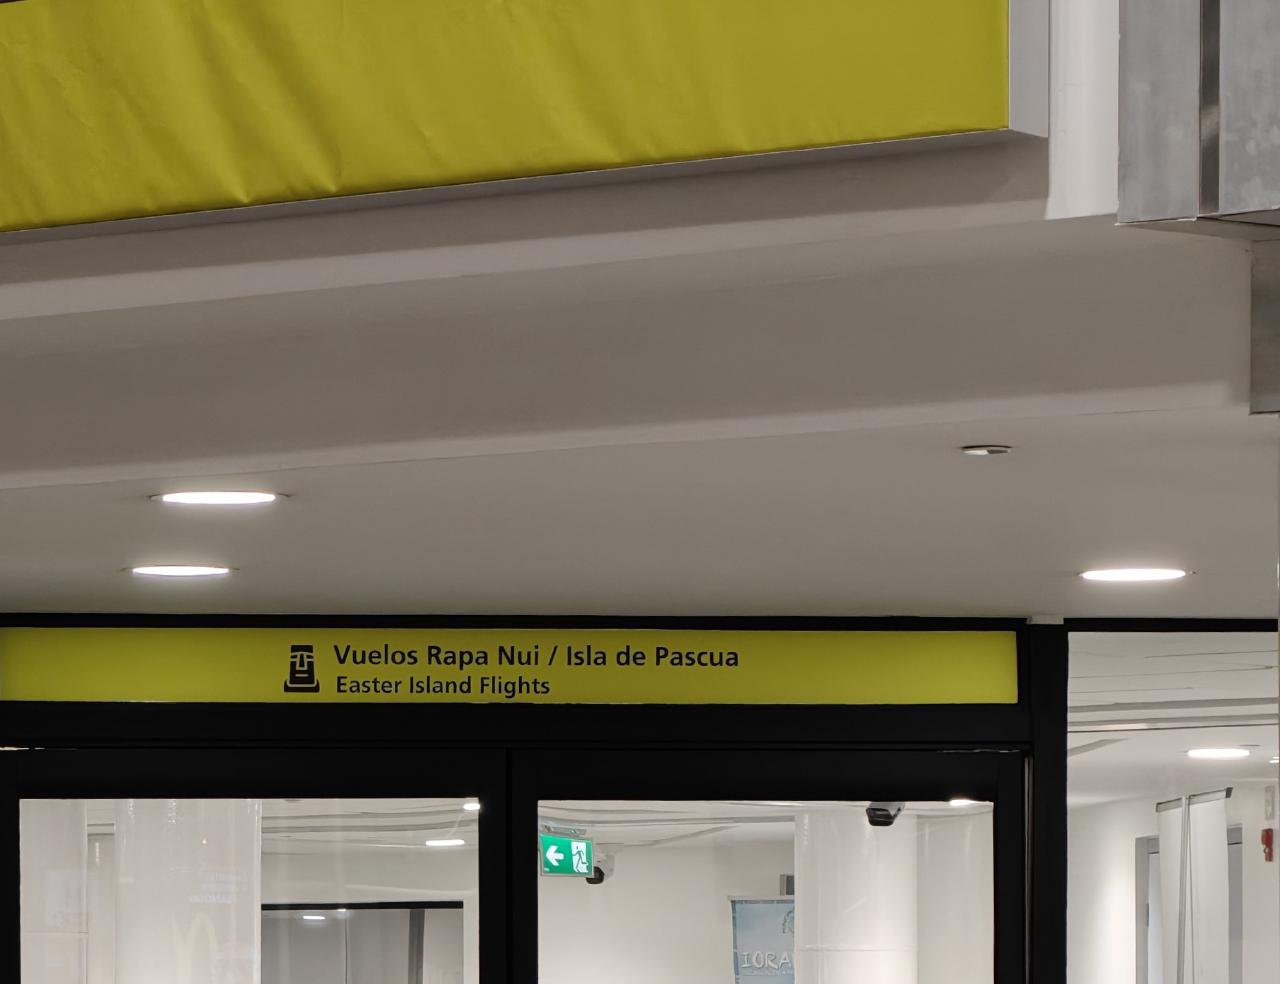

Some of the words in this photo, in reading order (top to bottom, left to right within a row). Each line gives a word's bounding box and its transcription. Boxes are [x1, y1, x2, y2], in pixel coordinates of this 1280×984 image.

[333, 643, 418, 666] Vuelos
[427, 645, 489, 671] Rapa
[498, 644, 539, 666] Nui
[547, 645, 558, 666] /
[567, 644, 607, 666] Isla
[616, 644, 646, 666] de
[655, 646, 739, 667] Pascua
[336, 675, 403, 694] Easter
[409, 675, 472, 694] Island
[480, 675, 550, 699] Flights
